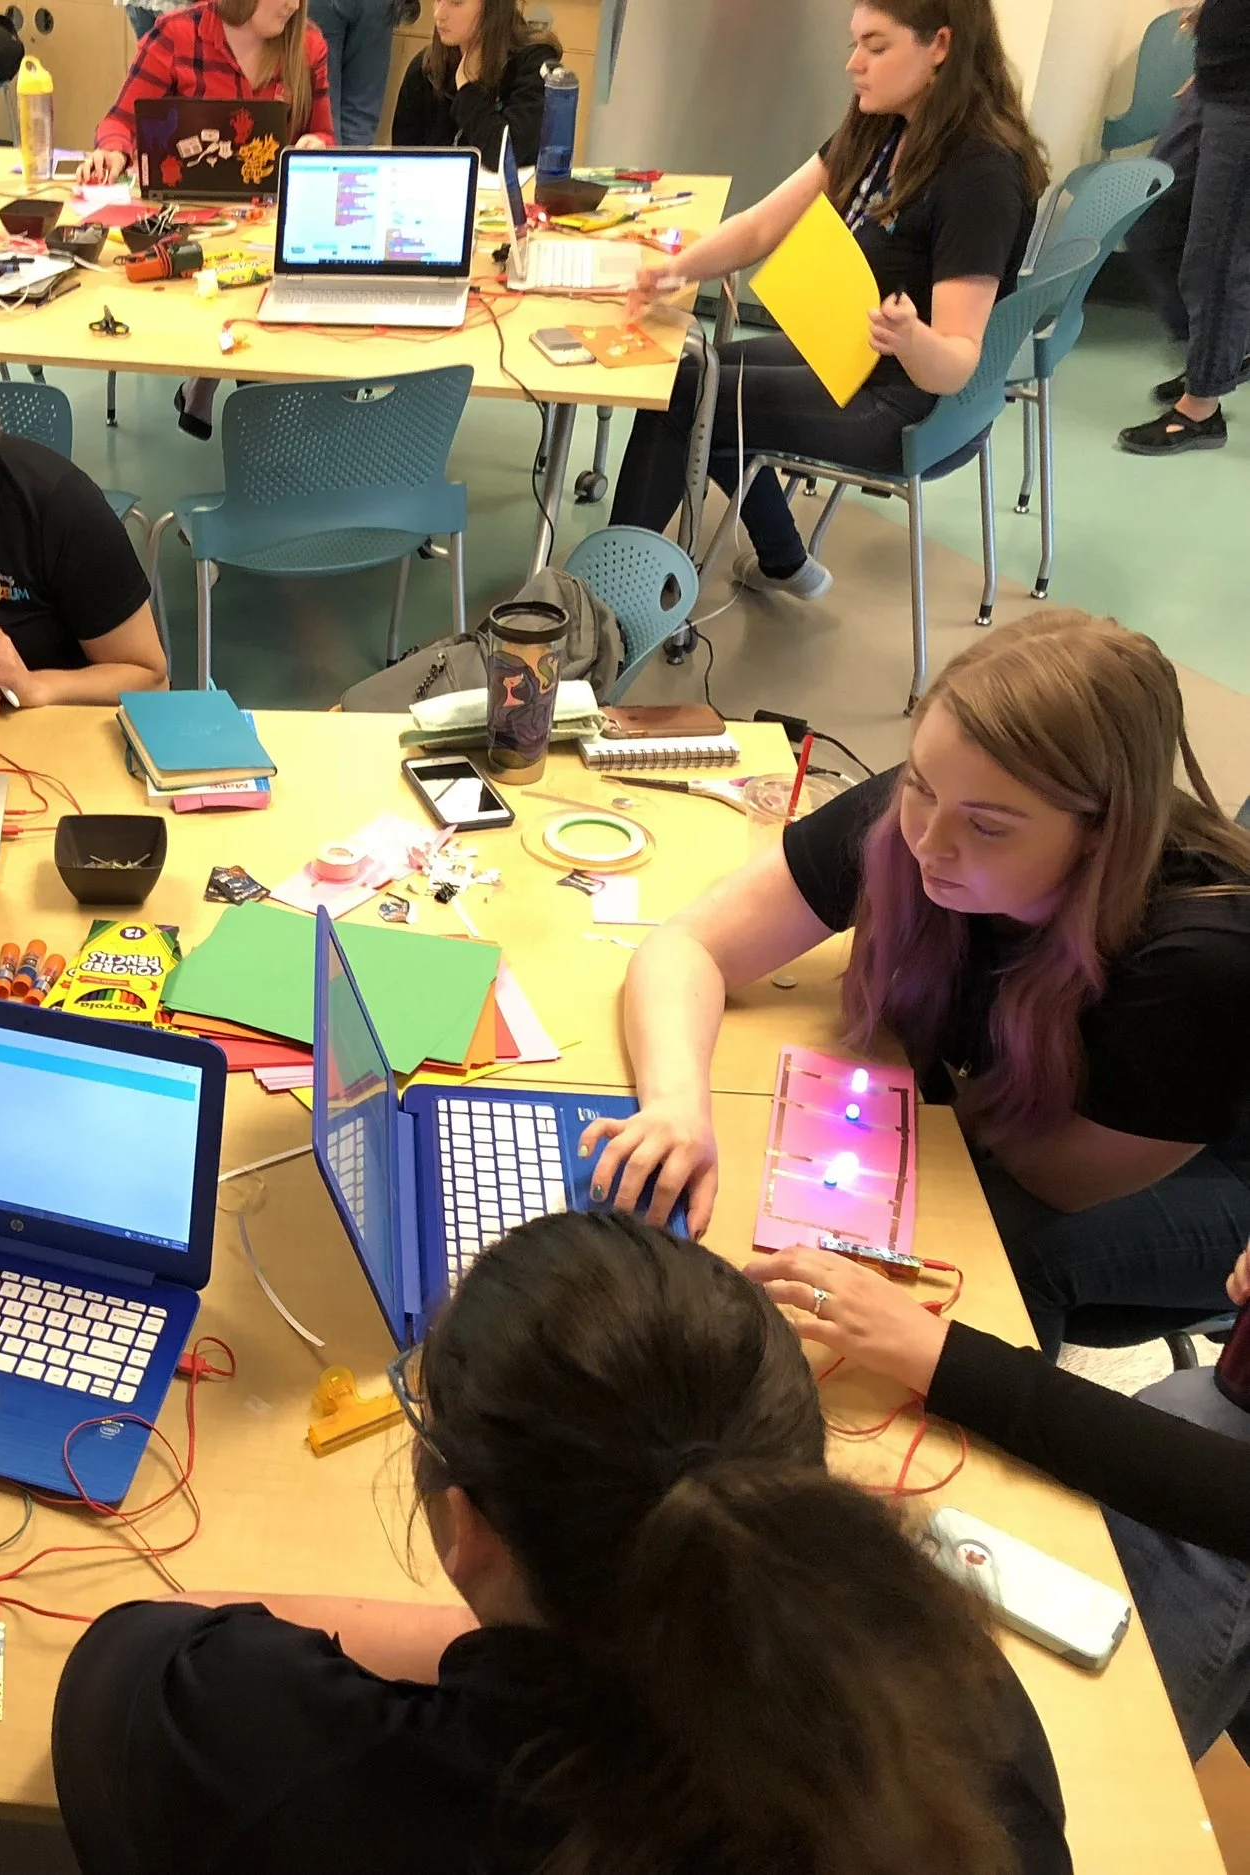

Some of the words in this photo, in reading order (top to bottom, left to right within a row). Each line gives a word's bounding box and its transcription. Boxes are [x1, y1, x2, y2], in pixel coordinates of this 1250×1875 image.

[124, 929, 142, 938] 12
[88, 951, 161, 968] PENCILS
[80, 961, 163, 976] COLORED
[80, 1001, 141, 1014] Crayola
